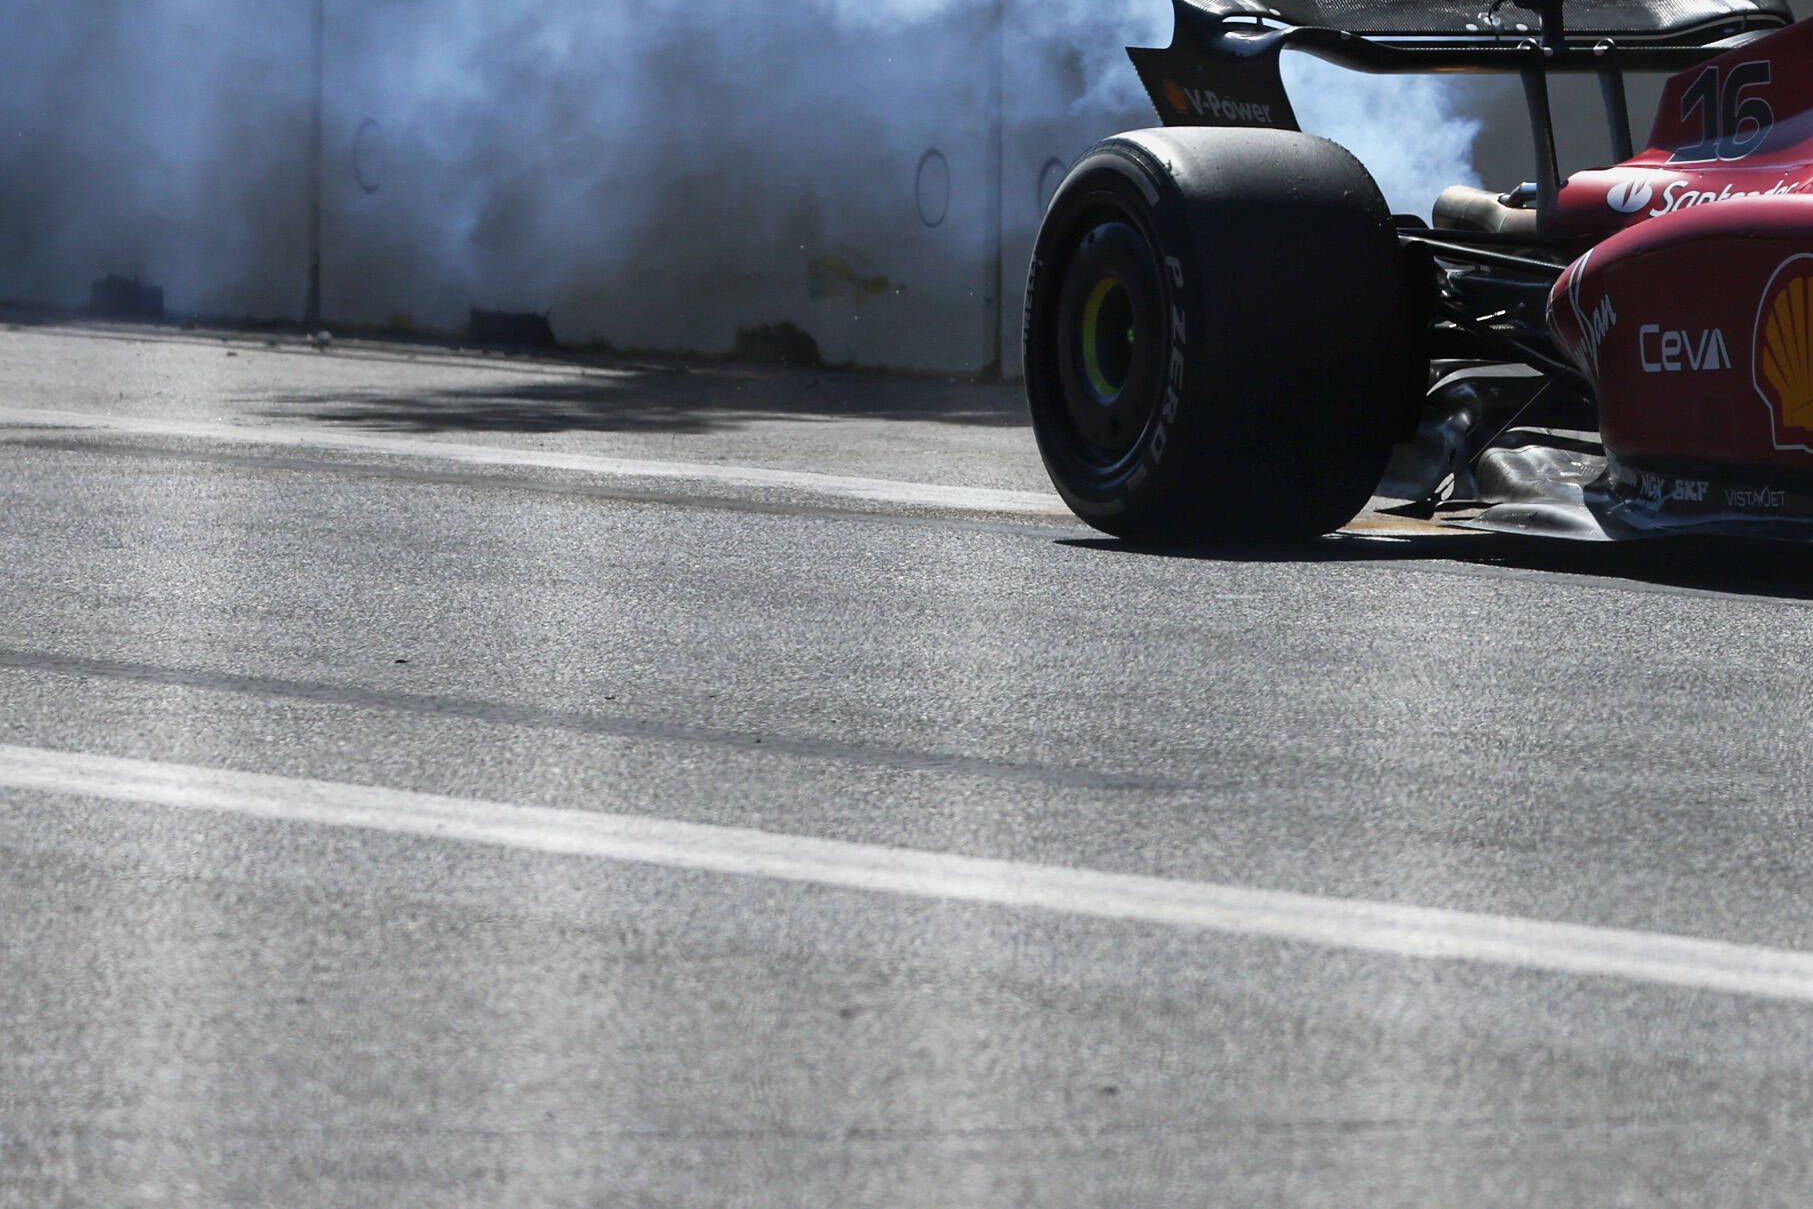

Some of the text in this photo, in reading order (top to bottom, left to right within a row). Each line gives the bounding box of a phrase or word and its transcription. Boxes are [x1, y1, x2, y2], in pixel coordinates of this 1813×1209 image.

[1183, 88, 1273, 123] V-Power
[1665, 59, 1775, 164] 16
[1151, 303, 1187, 466] ZERO
